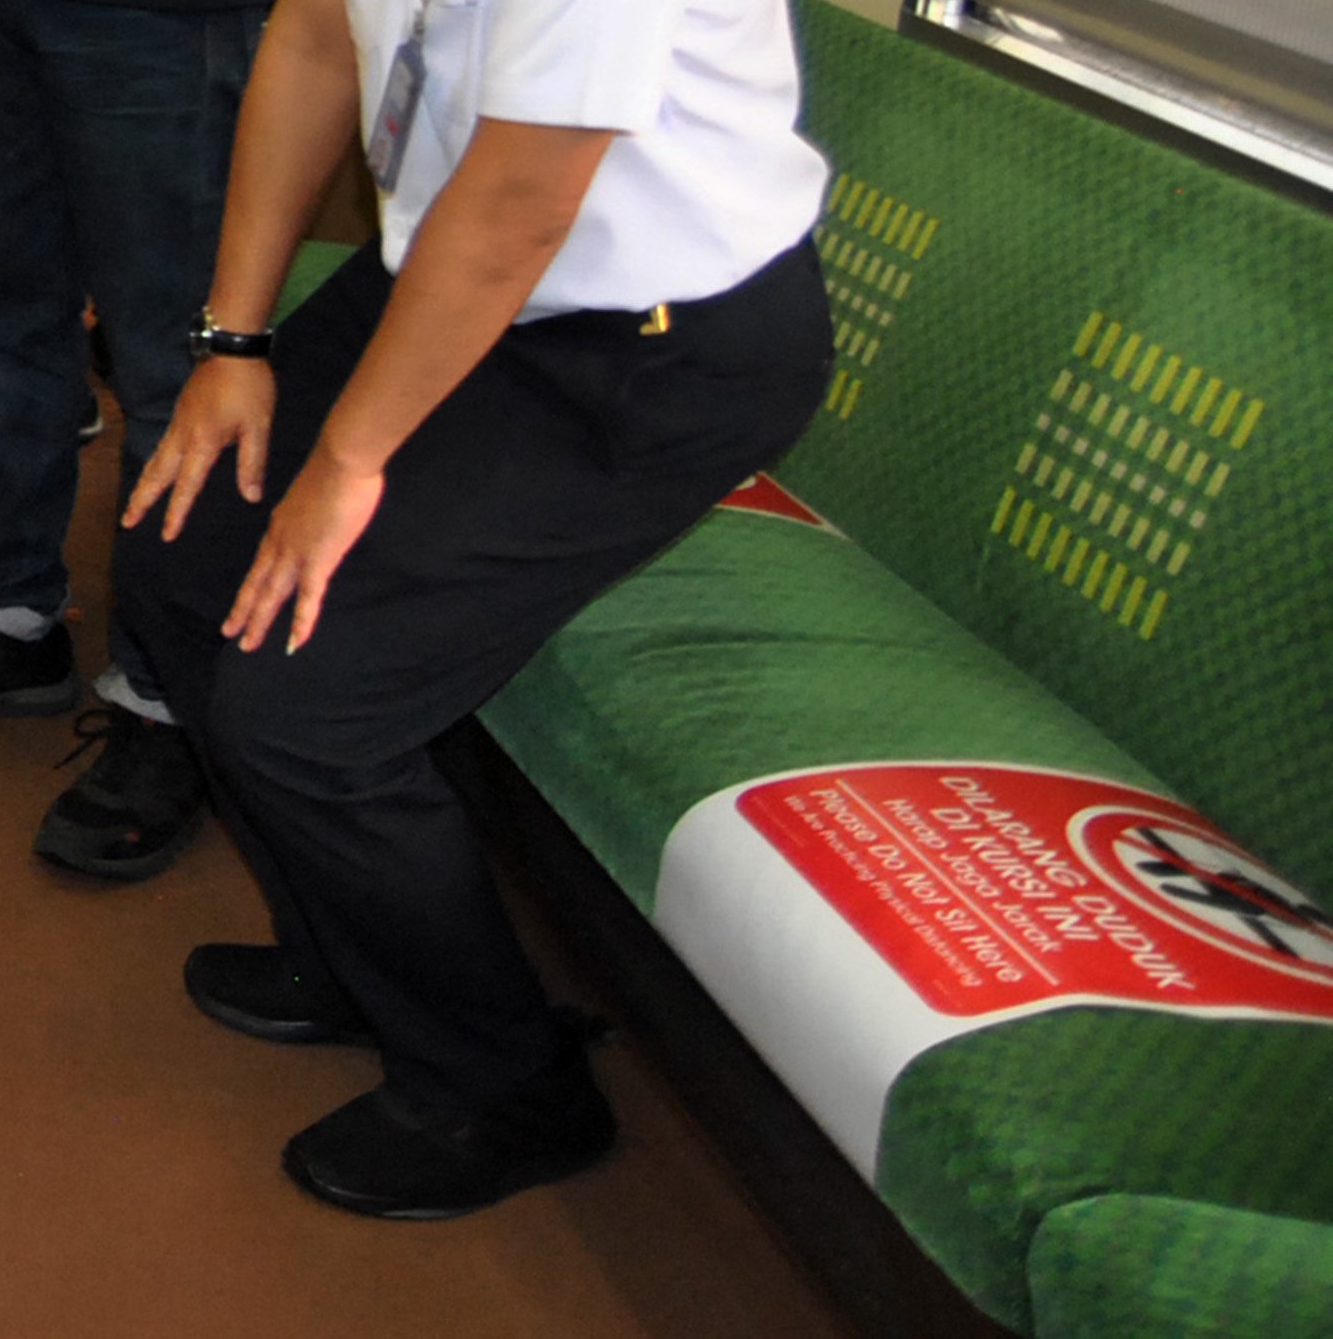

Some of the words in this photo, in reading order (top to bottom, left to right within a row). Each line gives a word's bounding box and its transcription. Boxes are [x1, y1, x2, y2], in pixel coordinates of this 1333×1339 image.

[809, 787, 877, 844] Please
[867, 842, 906, 873] Do
[897, 868, 952, 907] Not
[934, 907, 978, 933] Sit
[960, 927, 1025, 983] Here
[883, 797, 948, 854] Harap
[940, 852, 1002, 899] Jaga
[992, 899, 1066, 954] Jarak
[929, 806, 981, 831] DI
[961, 835, 1056, 900] KURSI
[1037, 904, 1102, 942] INI
[938, 775, 1088, 888] DILARANG
[1074, 894, 1197, 991] DUDUK
